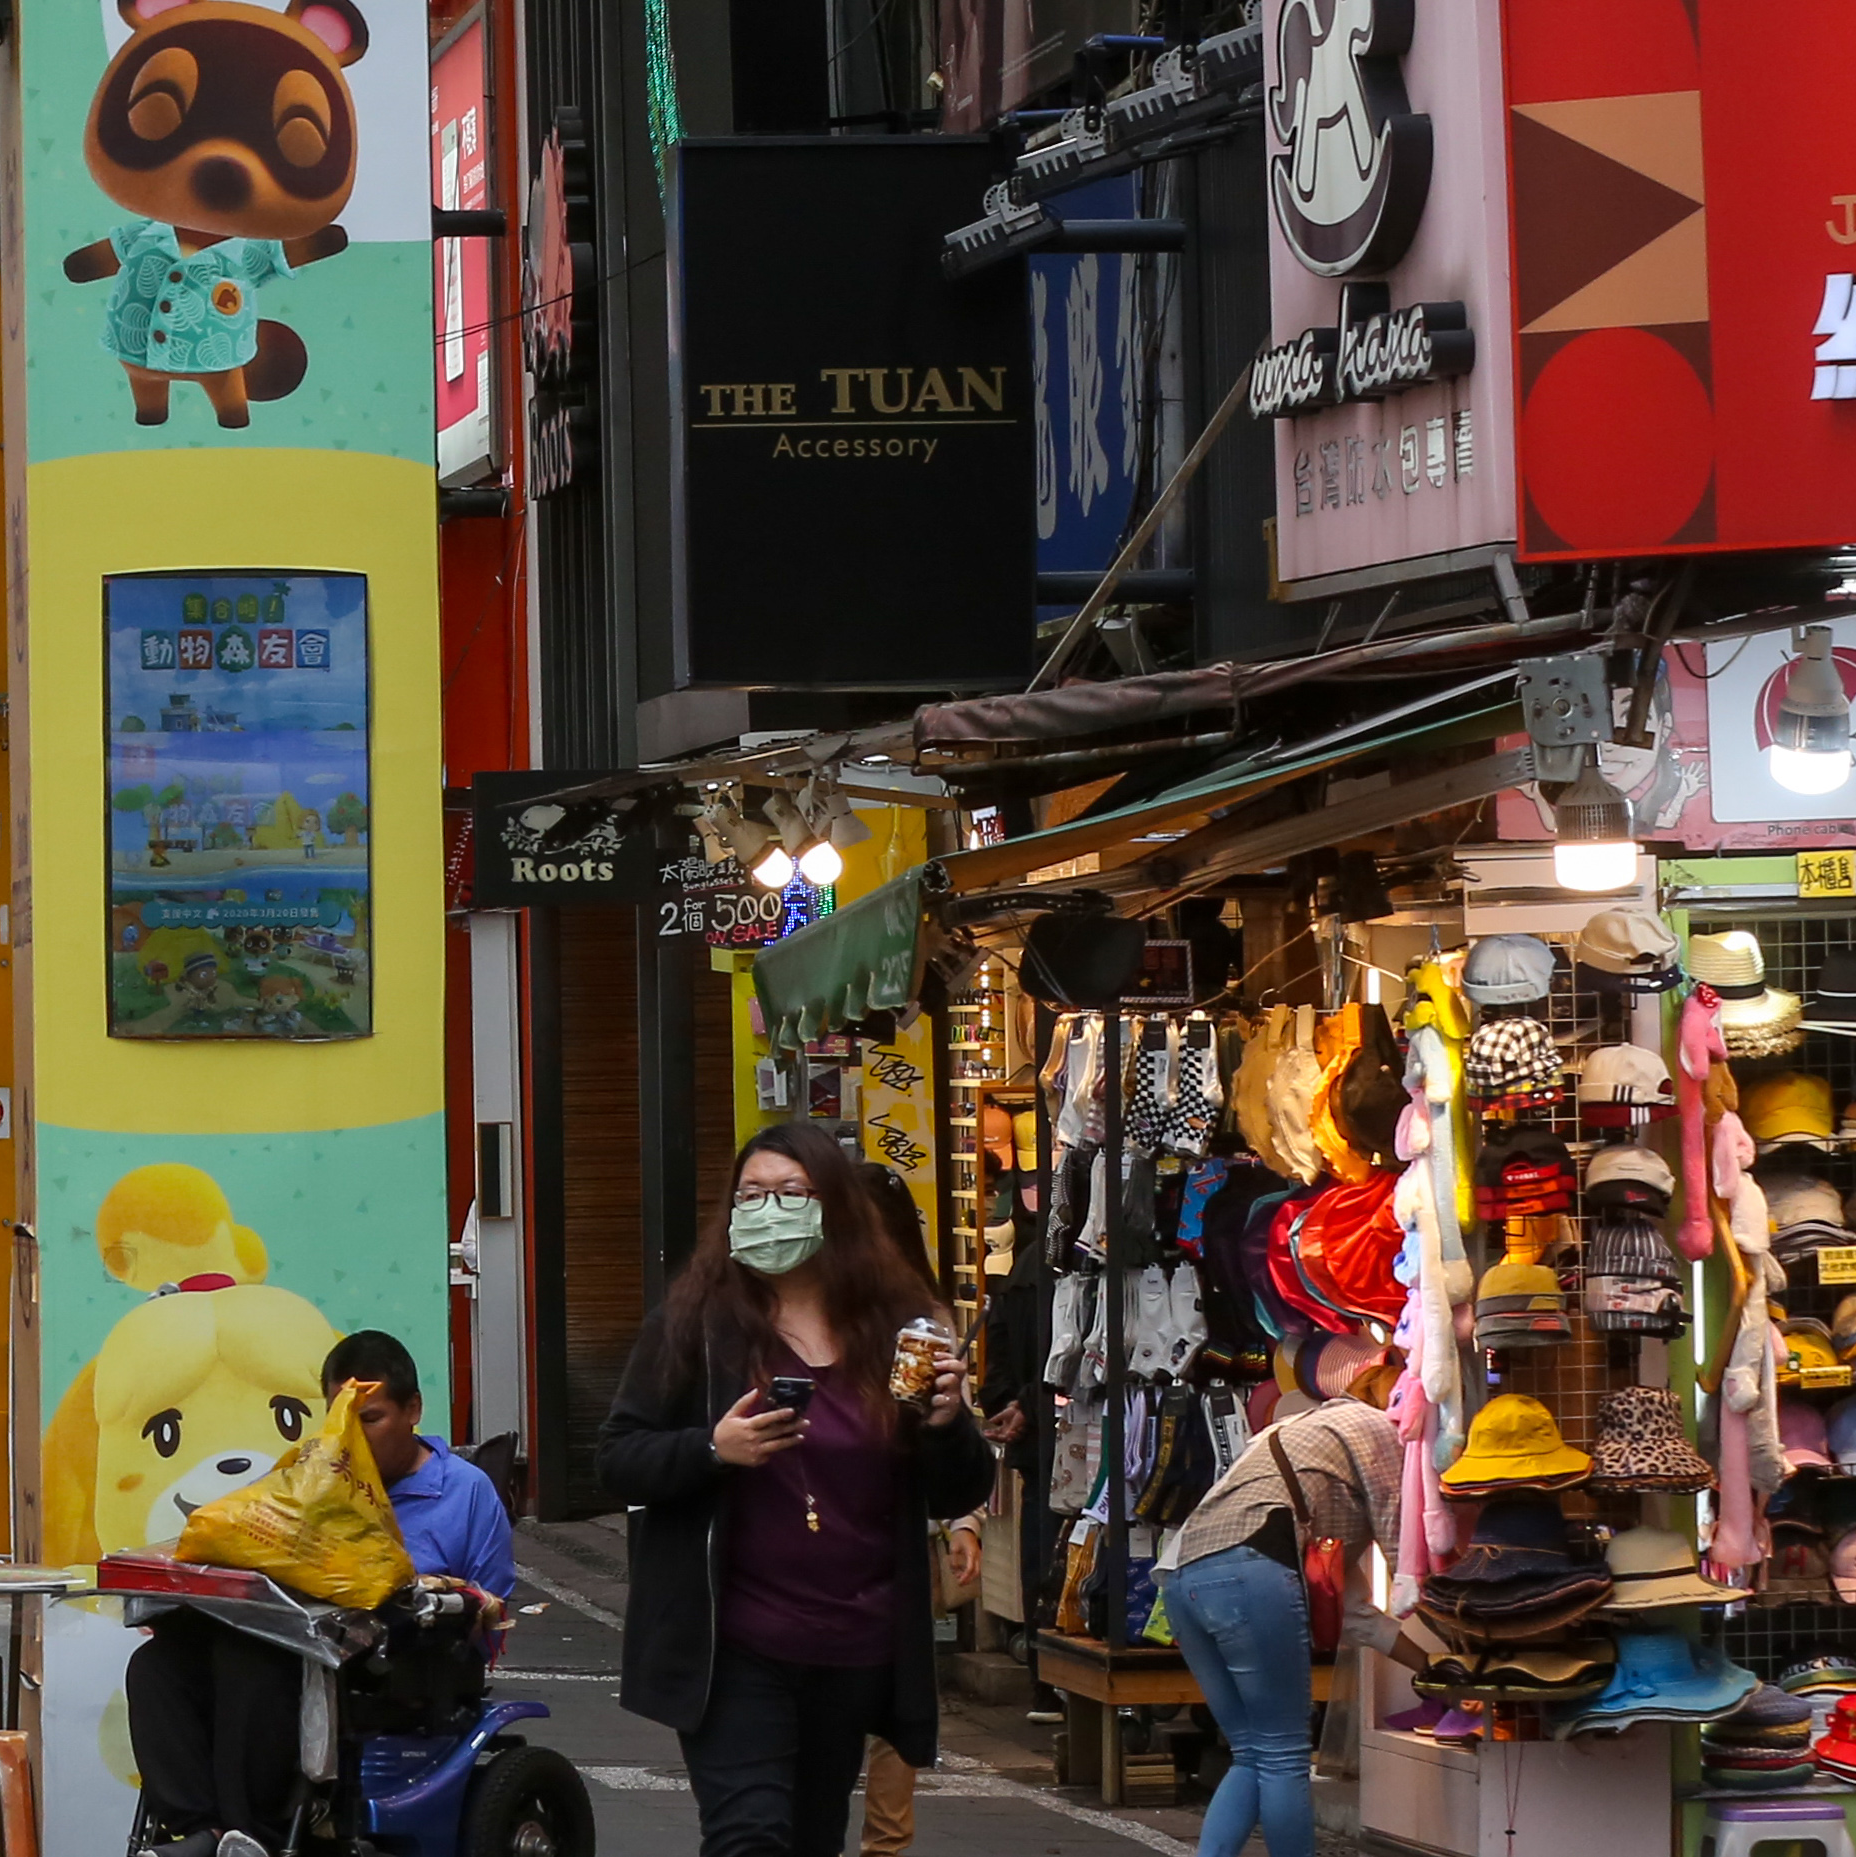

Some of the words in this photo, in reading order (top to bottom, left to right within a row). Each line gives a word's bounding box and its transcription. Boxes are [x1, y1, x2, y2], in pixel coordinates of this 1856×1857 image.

[700, 383, 798, 416] THE
[820, 366, 1008, 415] TUAN
[772, 433, 939, 465] Accessory
[142, 632, 329, 666] 動物森友會
[1767, 824, 1810, 836] Phone
[510, 856, 615, 885] Roots
[710, 891, 782, 933] 500
[731, 920, 779, 942] SALE
